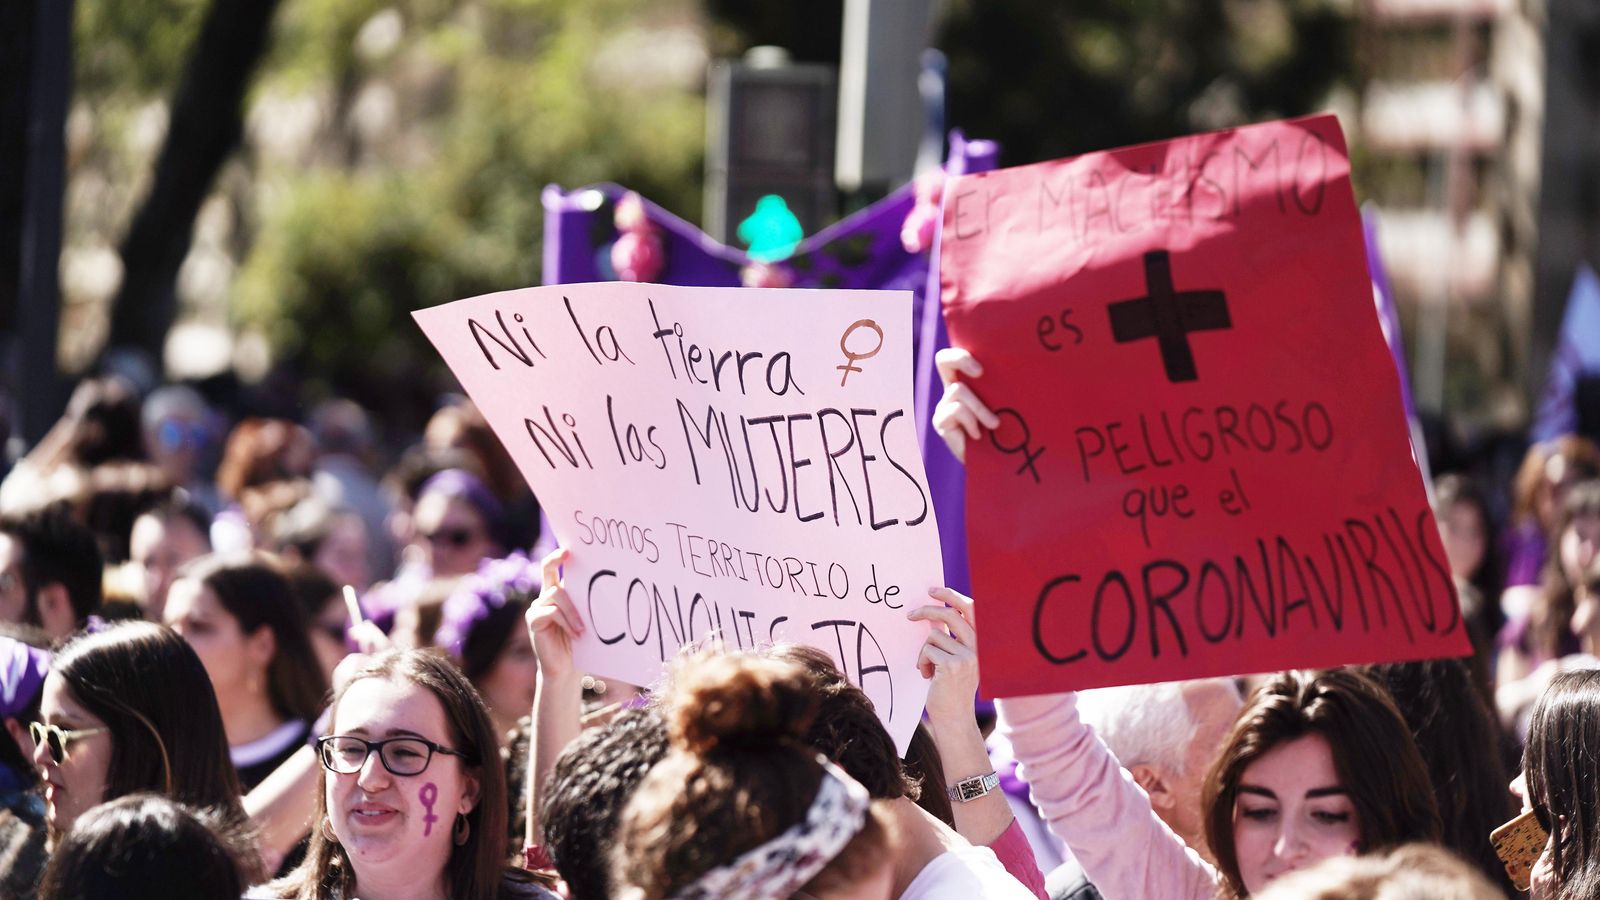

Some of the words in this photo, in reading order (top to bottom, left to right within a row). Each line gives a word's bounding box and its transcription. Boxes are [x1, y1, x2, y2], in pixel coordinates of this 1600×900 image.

[1036, 130, 1327, 246] MACHISMO
[467, 310, 546, 370] Ni
[563, 296, 635, 365] la
[648, 298, 804, 395] tierra
[1037, 308, 1083, 352] es
[524, 405, 593, 469] Ni
[606, 395, 666, 469] las
[676, 398, 927, 530] MUJERES
[1076, 400, 1333, 483] PELIGROSO
[1122, 483, 1195, 548] que
[1219, 468, 1250, 516] el
[574, 510, 659, 563] somos
[666, 522, 849, 600] TERRITORIO
[864, 564, 904, 609] de
[1032, 506, 1458, 666] CORONAVIRUS
